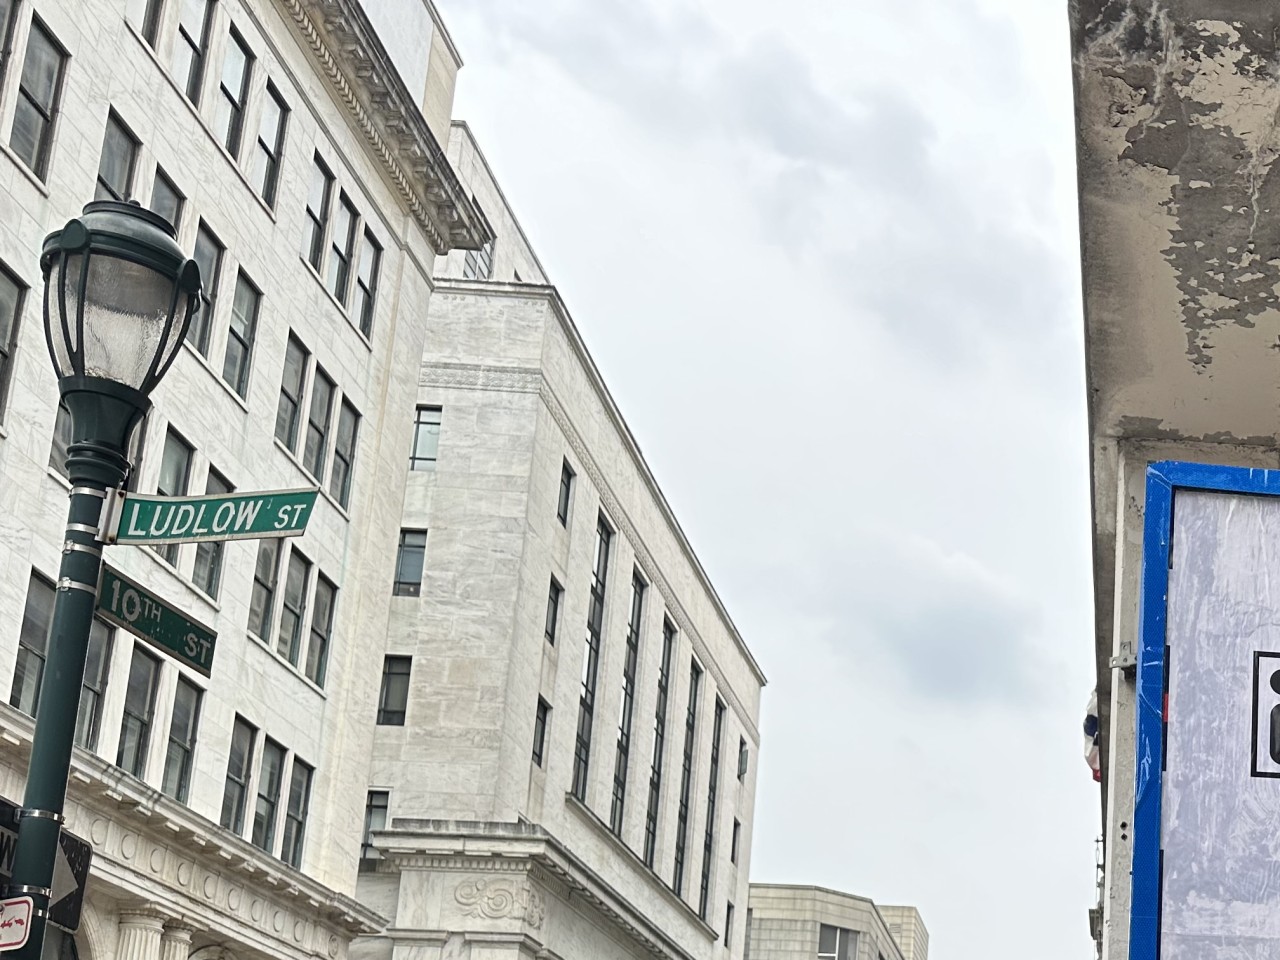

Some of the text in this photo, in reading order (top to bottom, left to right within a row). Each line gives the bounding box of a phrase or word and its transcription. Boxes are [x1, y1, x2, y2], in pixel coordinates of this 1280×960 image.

[127, 500, 307, 536] LUDLOW ST
[111, 579, 212, 664] 10TH ST
